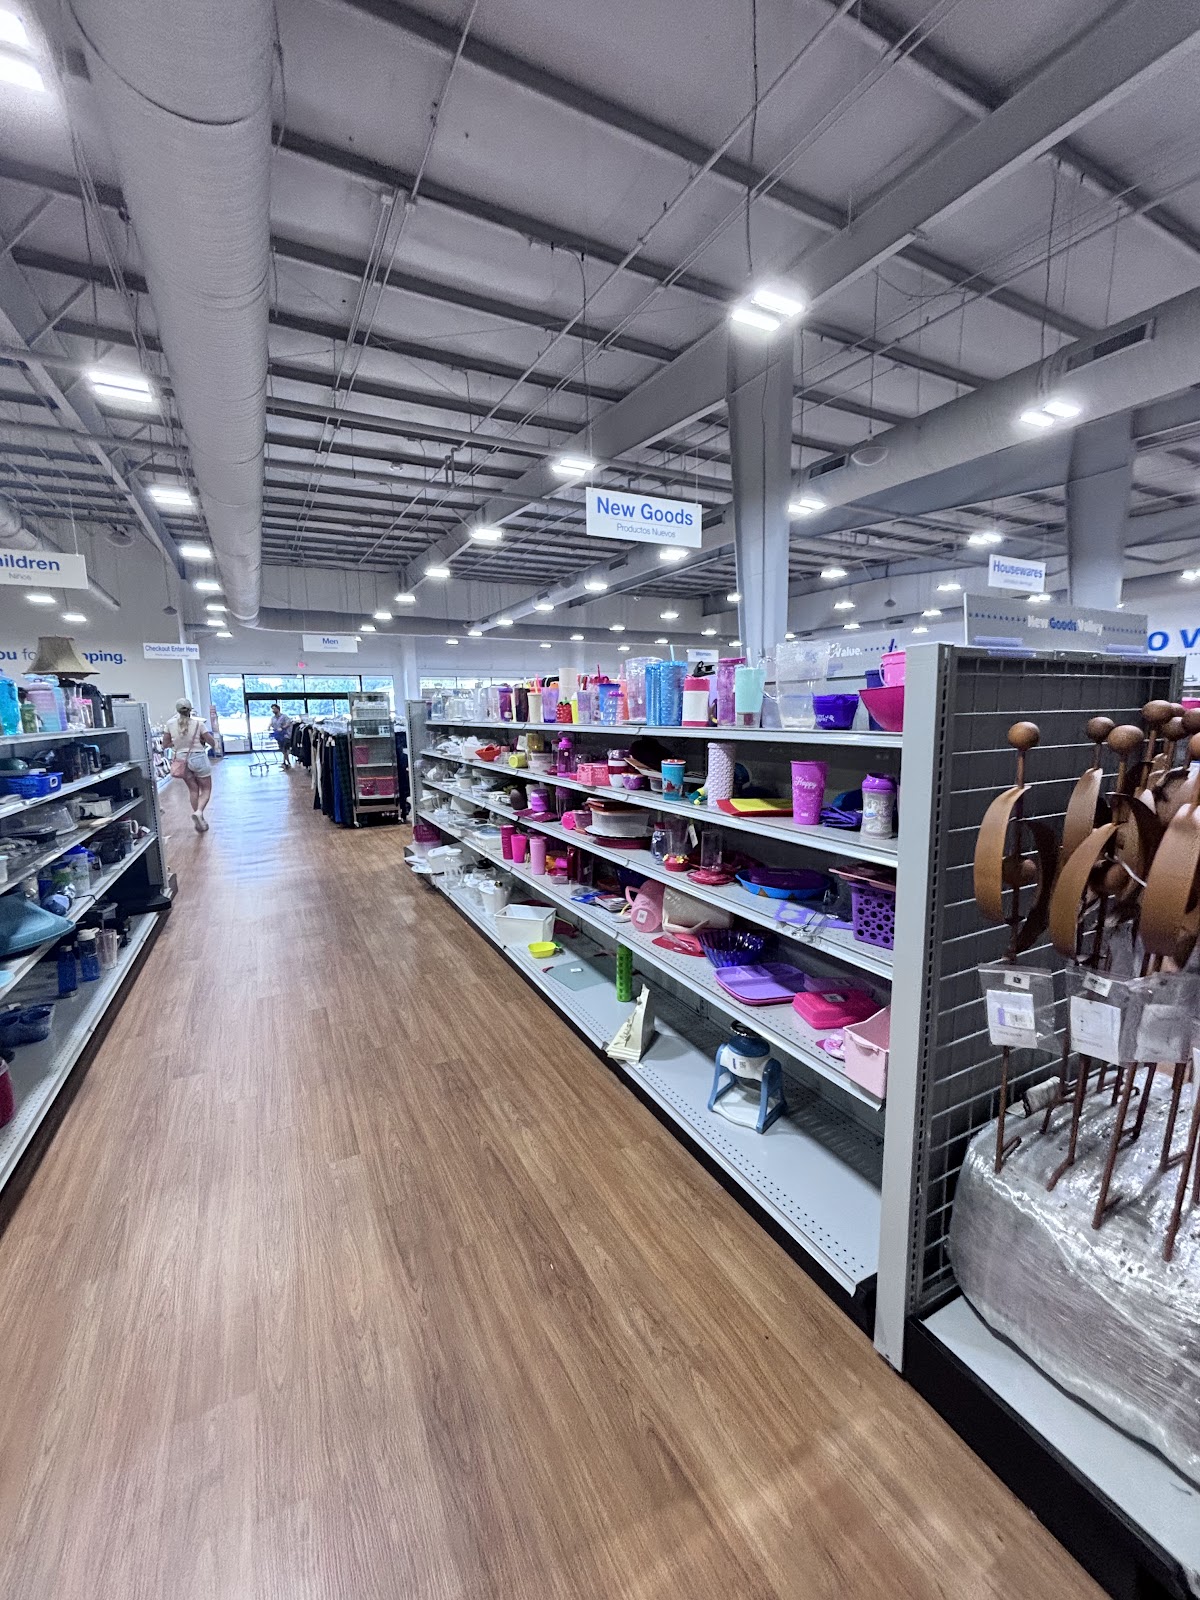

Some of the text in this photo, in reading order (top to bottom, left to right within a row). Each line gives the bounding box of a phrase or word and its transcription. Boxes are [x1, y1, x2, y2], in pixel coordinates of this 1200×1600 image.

[597, 497, 693, 525] New Goods
[616, 522, 676, 538] Productos Nuevos
[993, 559, 1043, 579] Housewares
[1027, 615, 1049, 629] New
[1049, 616, 1077, 632] Goods
[22, 648, 38, 660] fo
[82, 649, 127, 665] ping.
